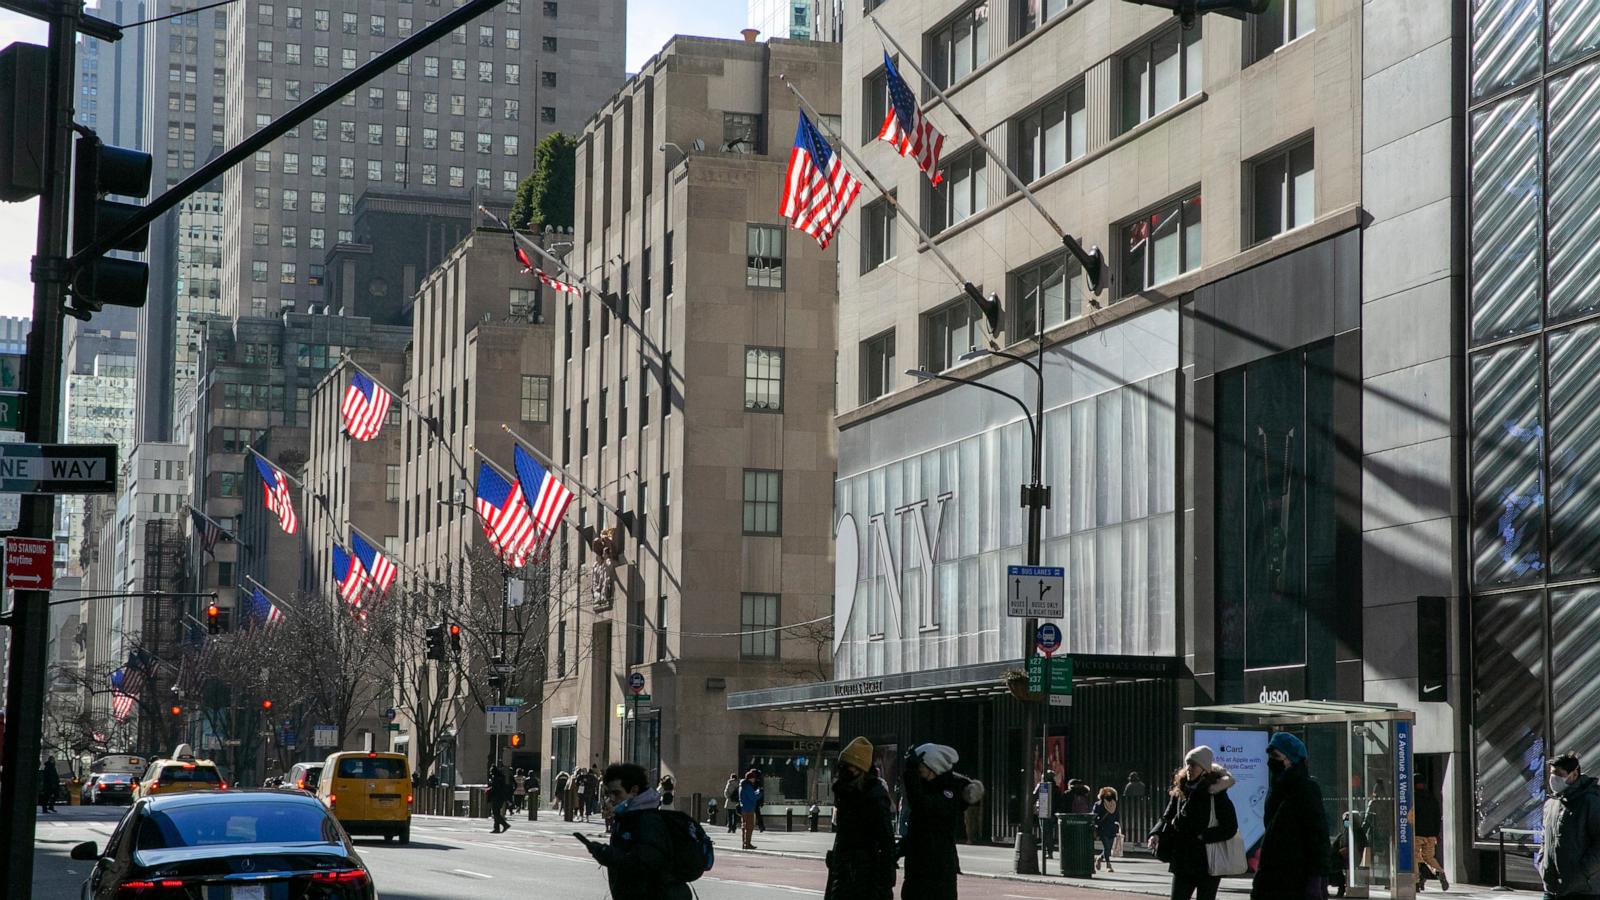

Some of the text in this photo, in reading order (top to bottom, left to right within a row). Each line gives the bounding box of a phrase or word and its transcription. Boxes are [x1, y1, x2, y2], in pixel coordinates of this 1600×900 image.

[51, 461, 97, 478] WAY
[8, 542, 47, 555] NO STANDING
[9, 554, 33, 566] Anytime
[1034, 568, 1051, 576] LANES
[1225, 745, 1243, 753] Card
[1233, 756, 1248, 764] Apple
[1398, 740, 1407, 771] Avenue
[1399, 782, 1407, 803] West
[1399, 805, 1407, 816] 52
